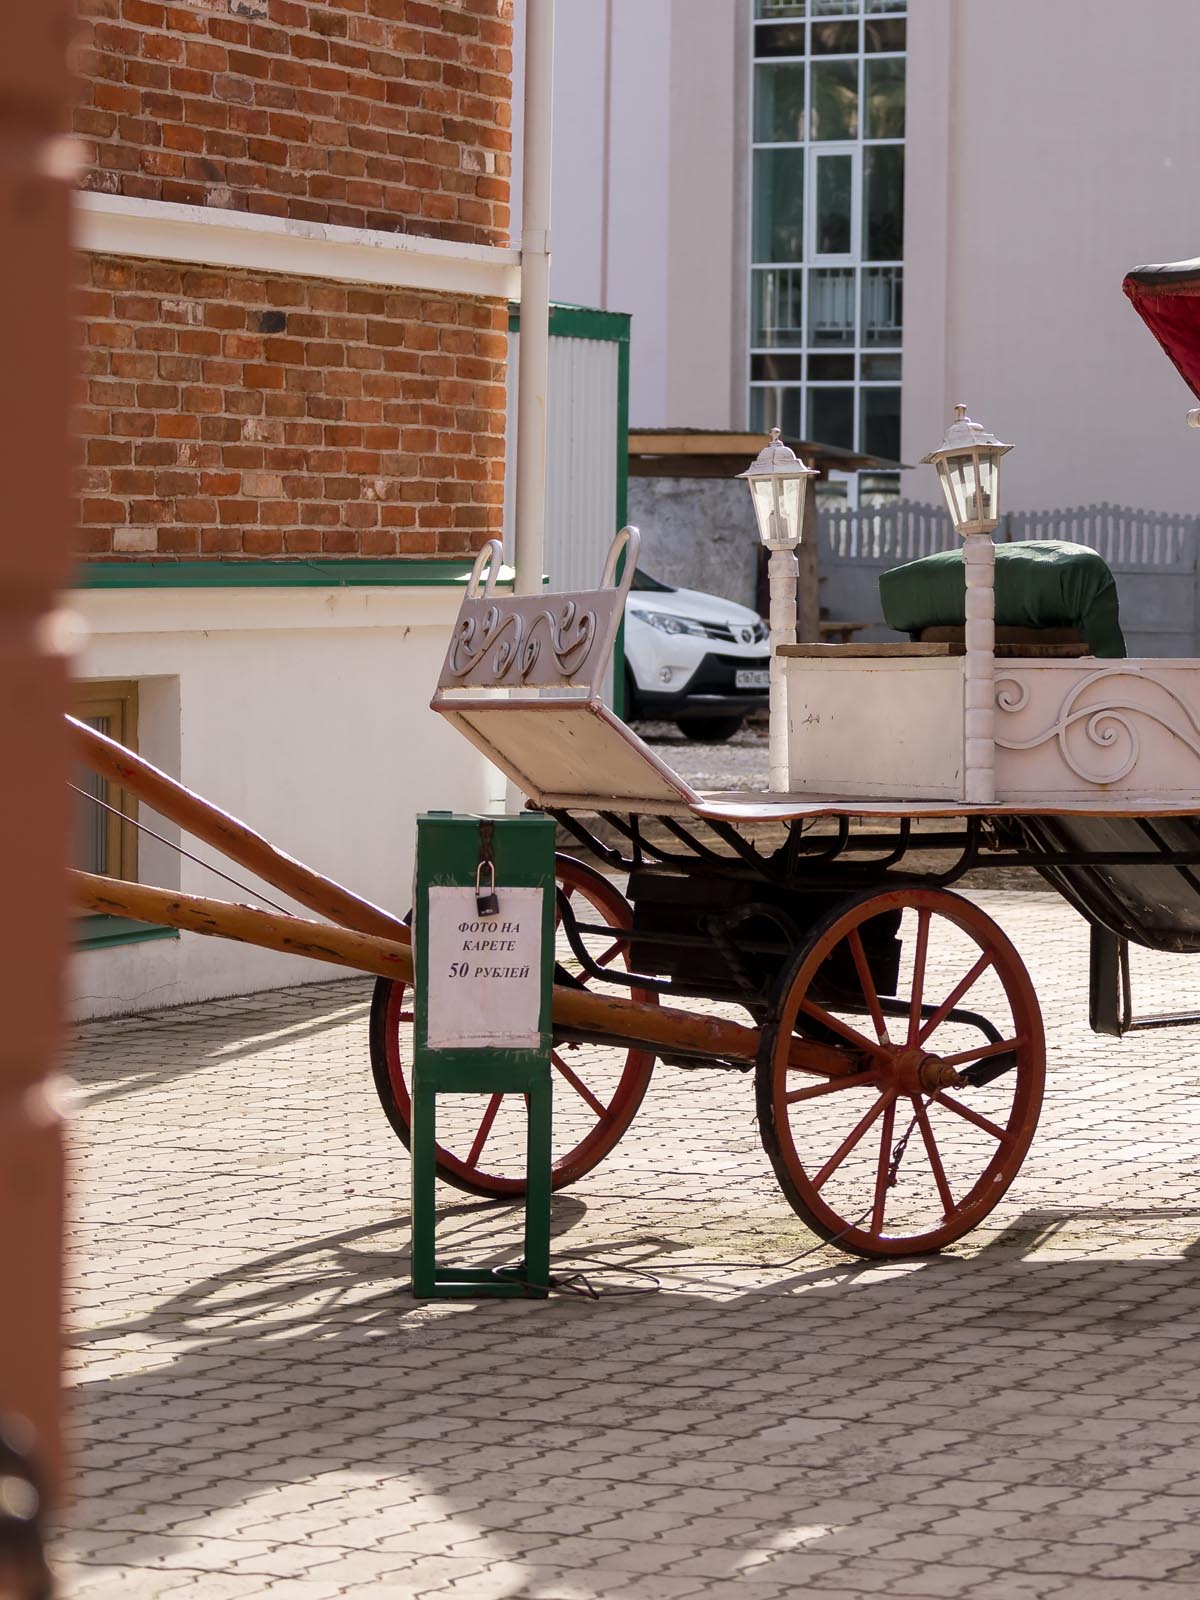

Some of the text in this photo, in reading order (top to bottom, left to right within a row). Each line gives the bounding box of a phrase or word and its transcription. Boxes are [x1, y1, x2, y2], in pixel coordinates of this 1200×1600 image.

[458, 922, 520, 933] ФОТО НА
[462, 940, 516, 951] КАРЕТЕ
[448, 962, 530, 978] 50 РУБЛЕЙ
